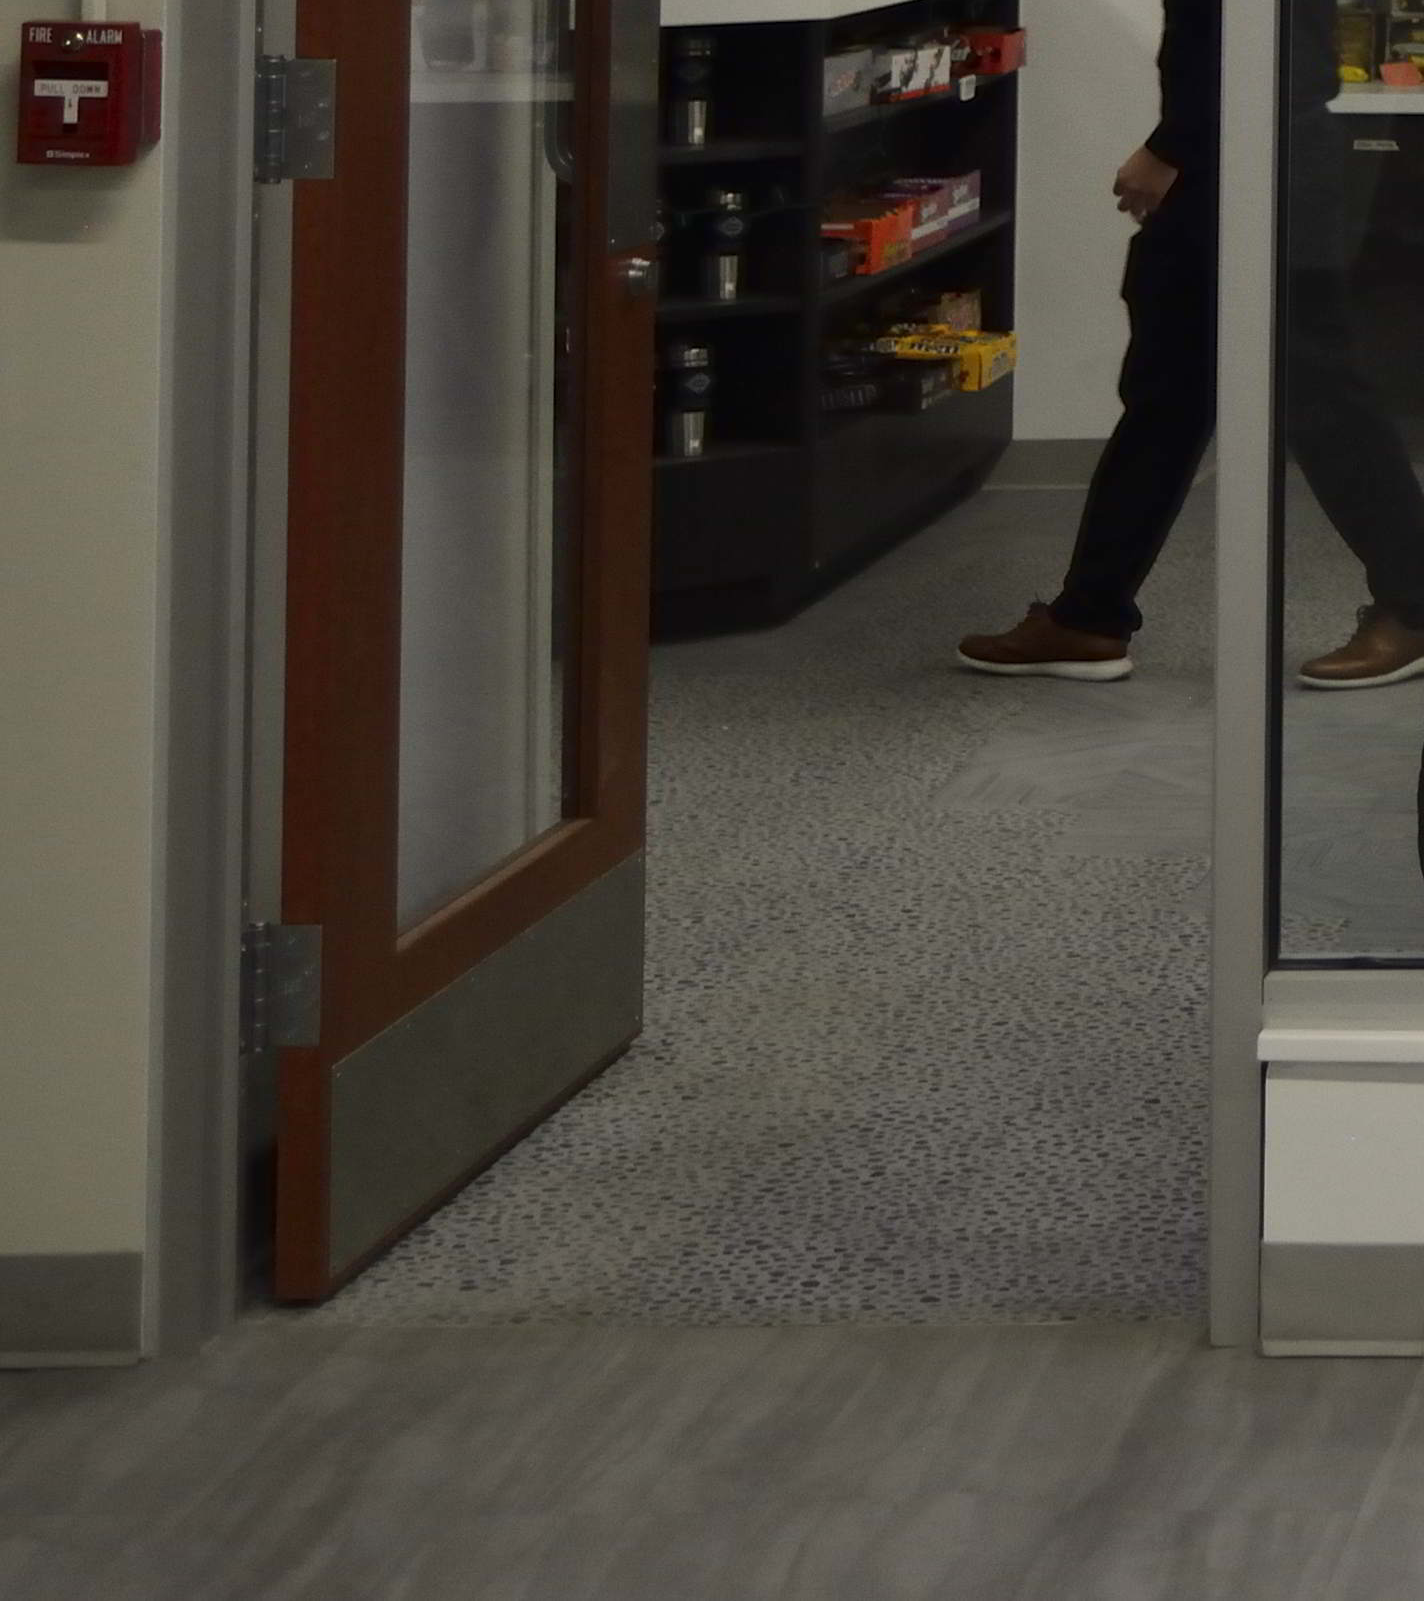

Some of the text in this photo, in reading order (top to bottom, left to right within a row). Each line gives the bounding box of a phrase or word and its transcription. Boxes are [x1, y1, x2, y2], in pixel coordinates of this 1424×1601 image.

[28, 26, 123, 46] FIRE ALARM
[39, 83, 103, 96] PULL DOWN
